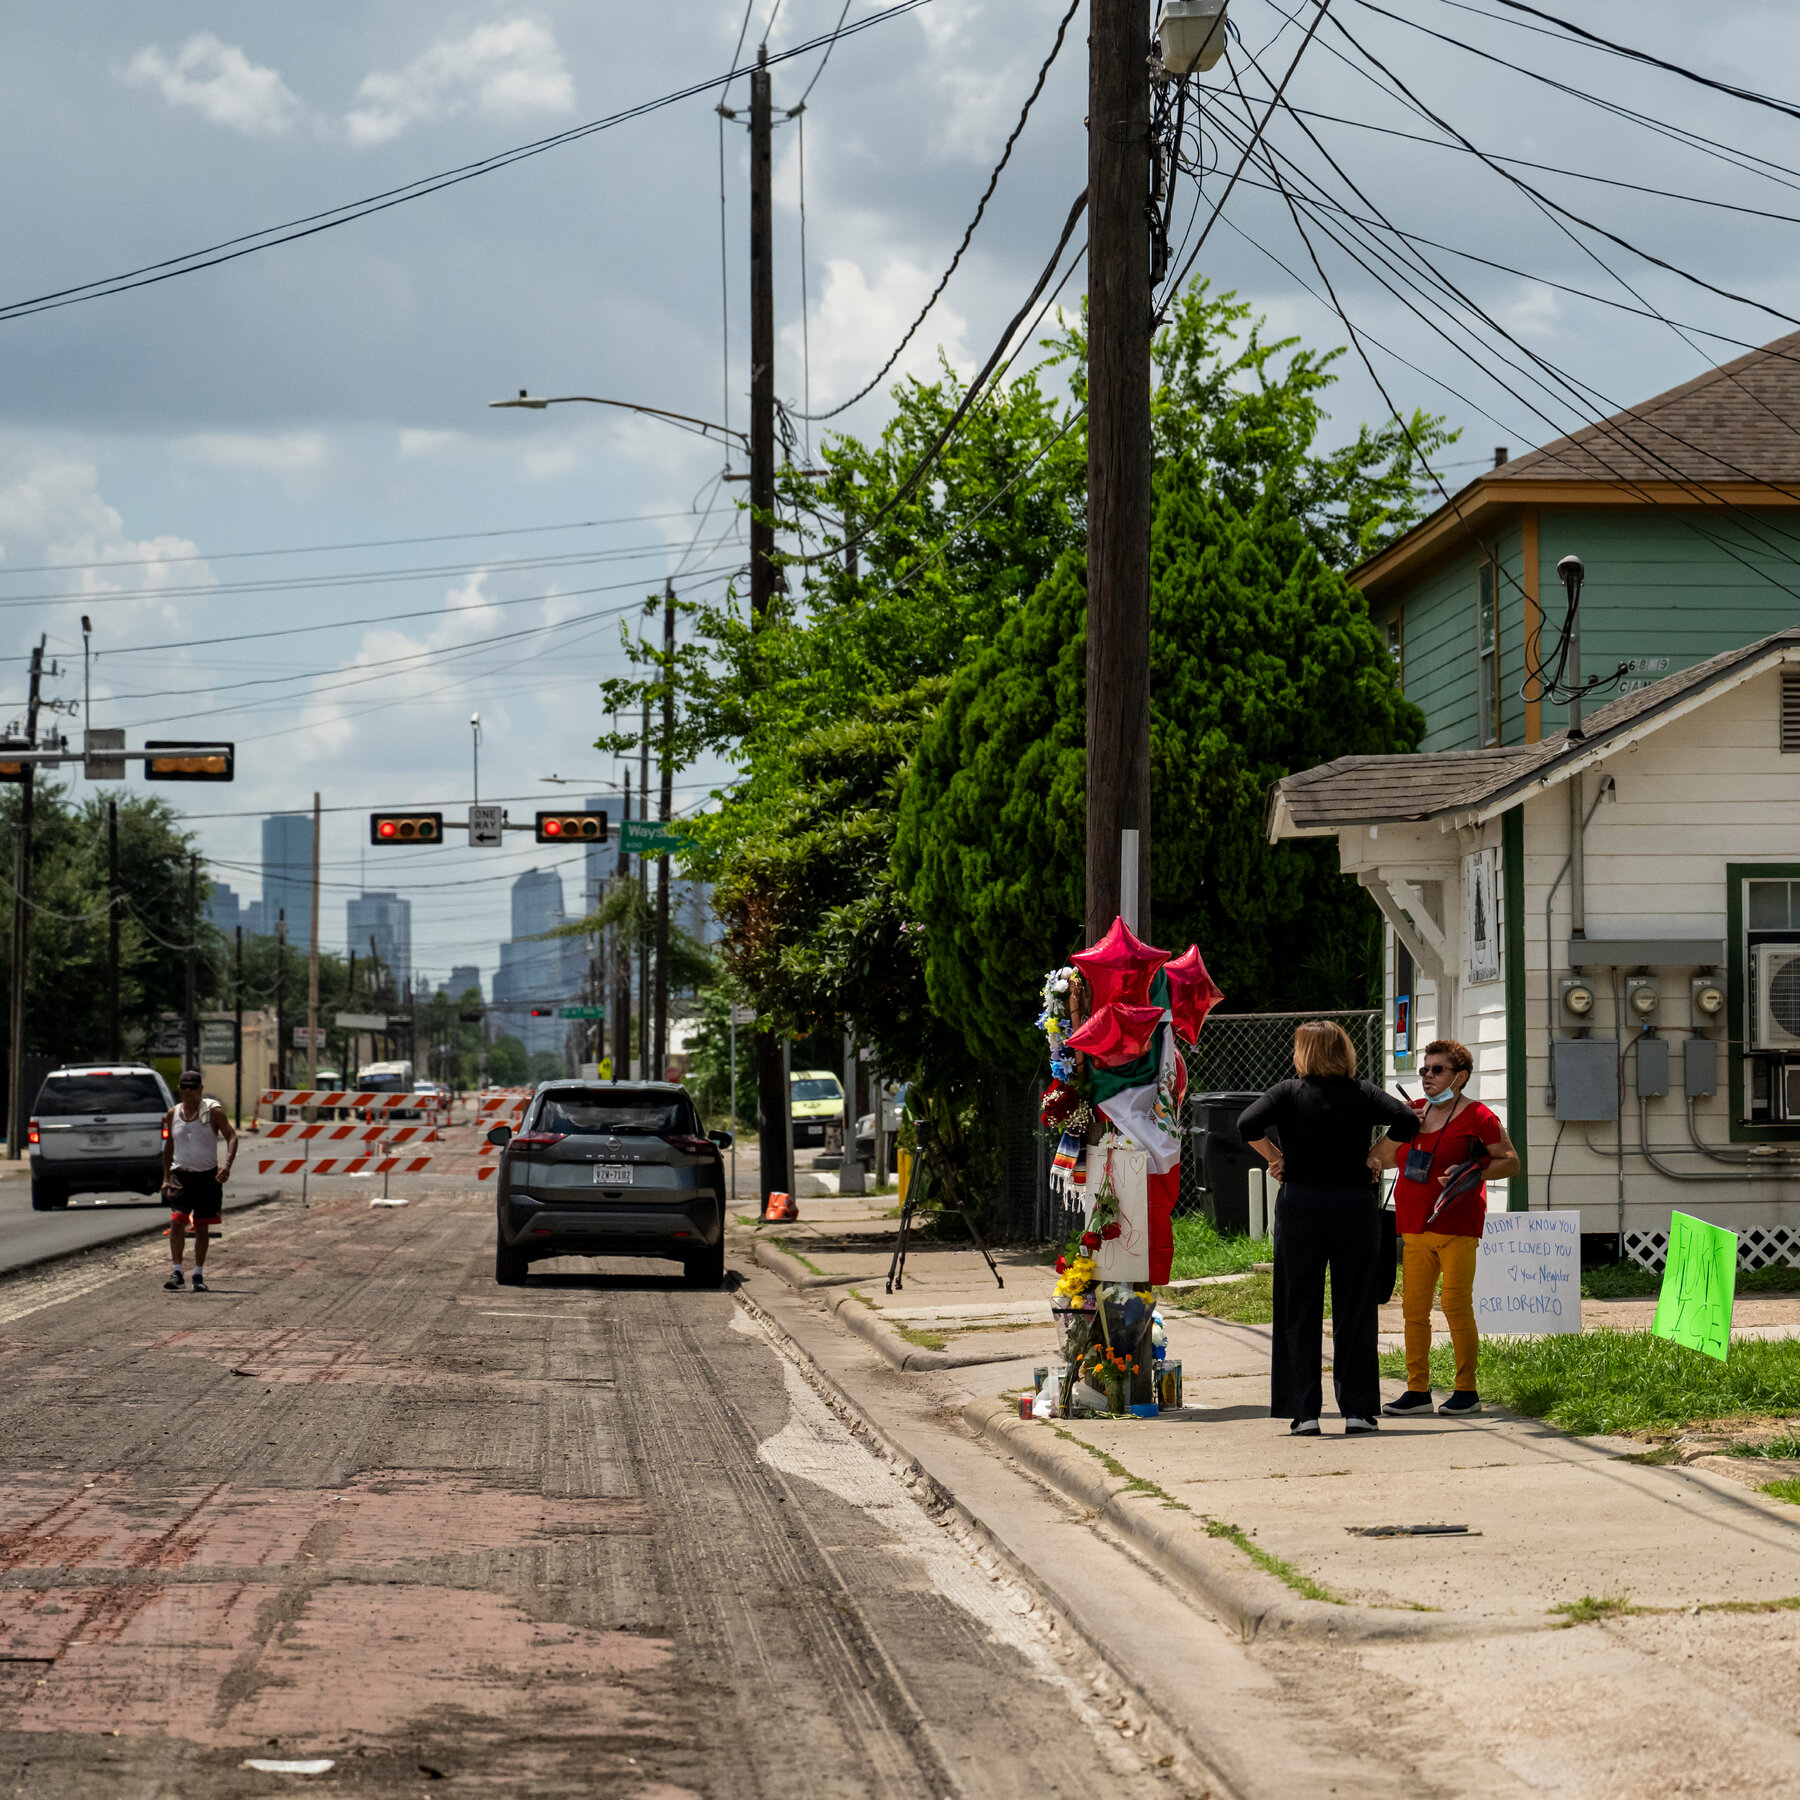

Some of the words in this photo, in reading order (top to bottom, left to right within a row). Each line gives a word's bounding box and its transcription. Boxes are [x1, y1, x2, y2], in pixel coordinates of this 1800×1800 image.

[1629, 659, 1668, 671] 689
[474, 810, 497, 820] ONE
[474, 821, 497, 830] WAY
[1528, 1218, 1557, 1232] KNOW
[1558, 1218, 1576, 1235] YOU
[1482, 1242, 1504, 1256] BUT
[1507, 1240, 1516, 1254] I
[1518, 1241, 1551, 1256] LOVED
[1555, 1242, 1572, 1257] YOU
[1520, 1268, 1536, 1284] Your
[1480, 1296, 1503, 1315] RIP
[1507, 1294, 1562, 1317] LORENZO
[1668, 1298, 1722, 1348] ICE
